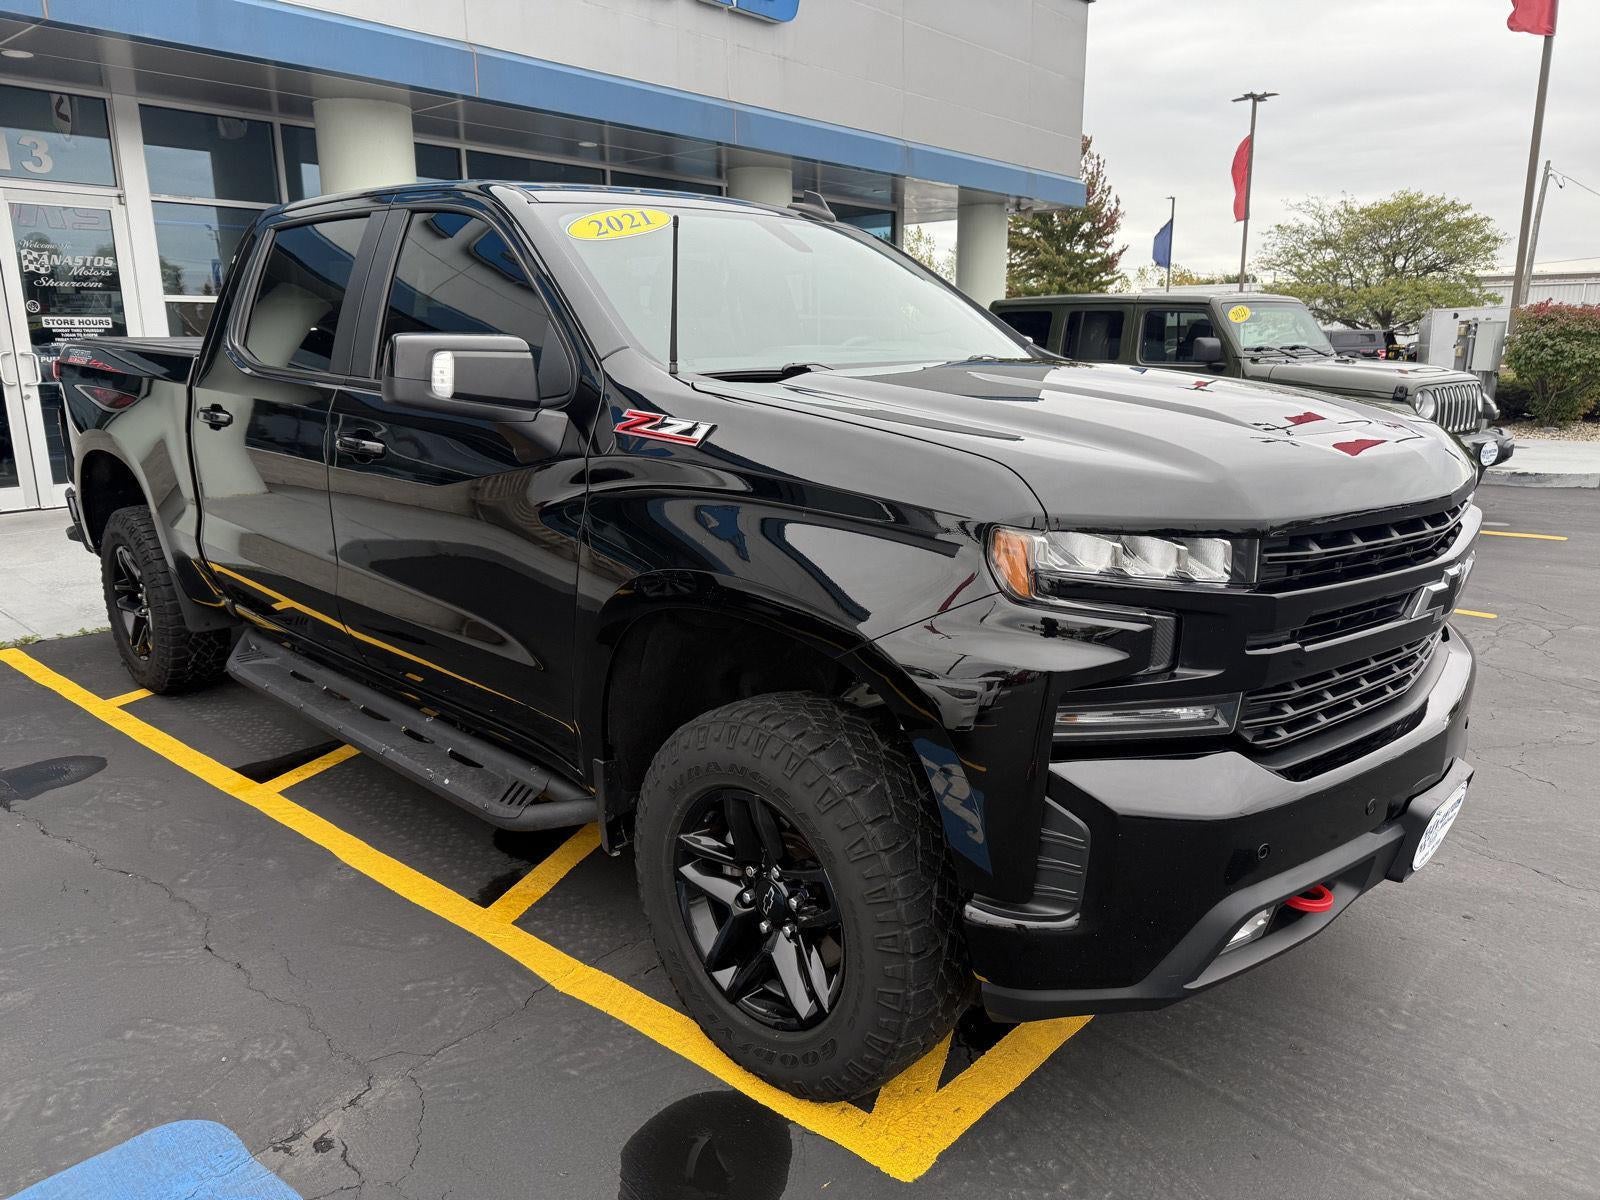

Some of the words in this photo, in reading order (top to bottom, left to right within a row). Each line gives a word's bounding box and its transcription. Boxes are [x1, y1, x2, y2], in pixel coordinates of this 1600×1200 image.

[588, 210, 655, 237] 2021
[20, 240, 57, 249] Welcome
[37, 254, 114, 267] ANASTOS
[69, 266, 112, 276] Motors
[33, 276, 103, 288] Showroom
[44, 318, 75, 326] STORE
[78, 318, 110, 326] HOURS
[613, 408, 718, 447] Z71
